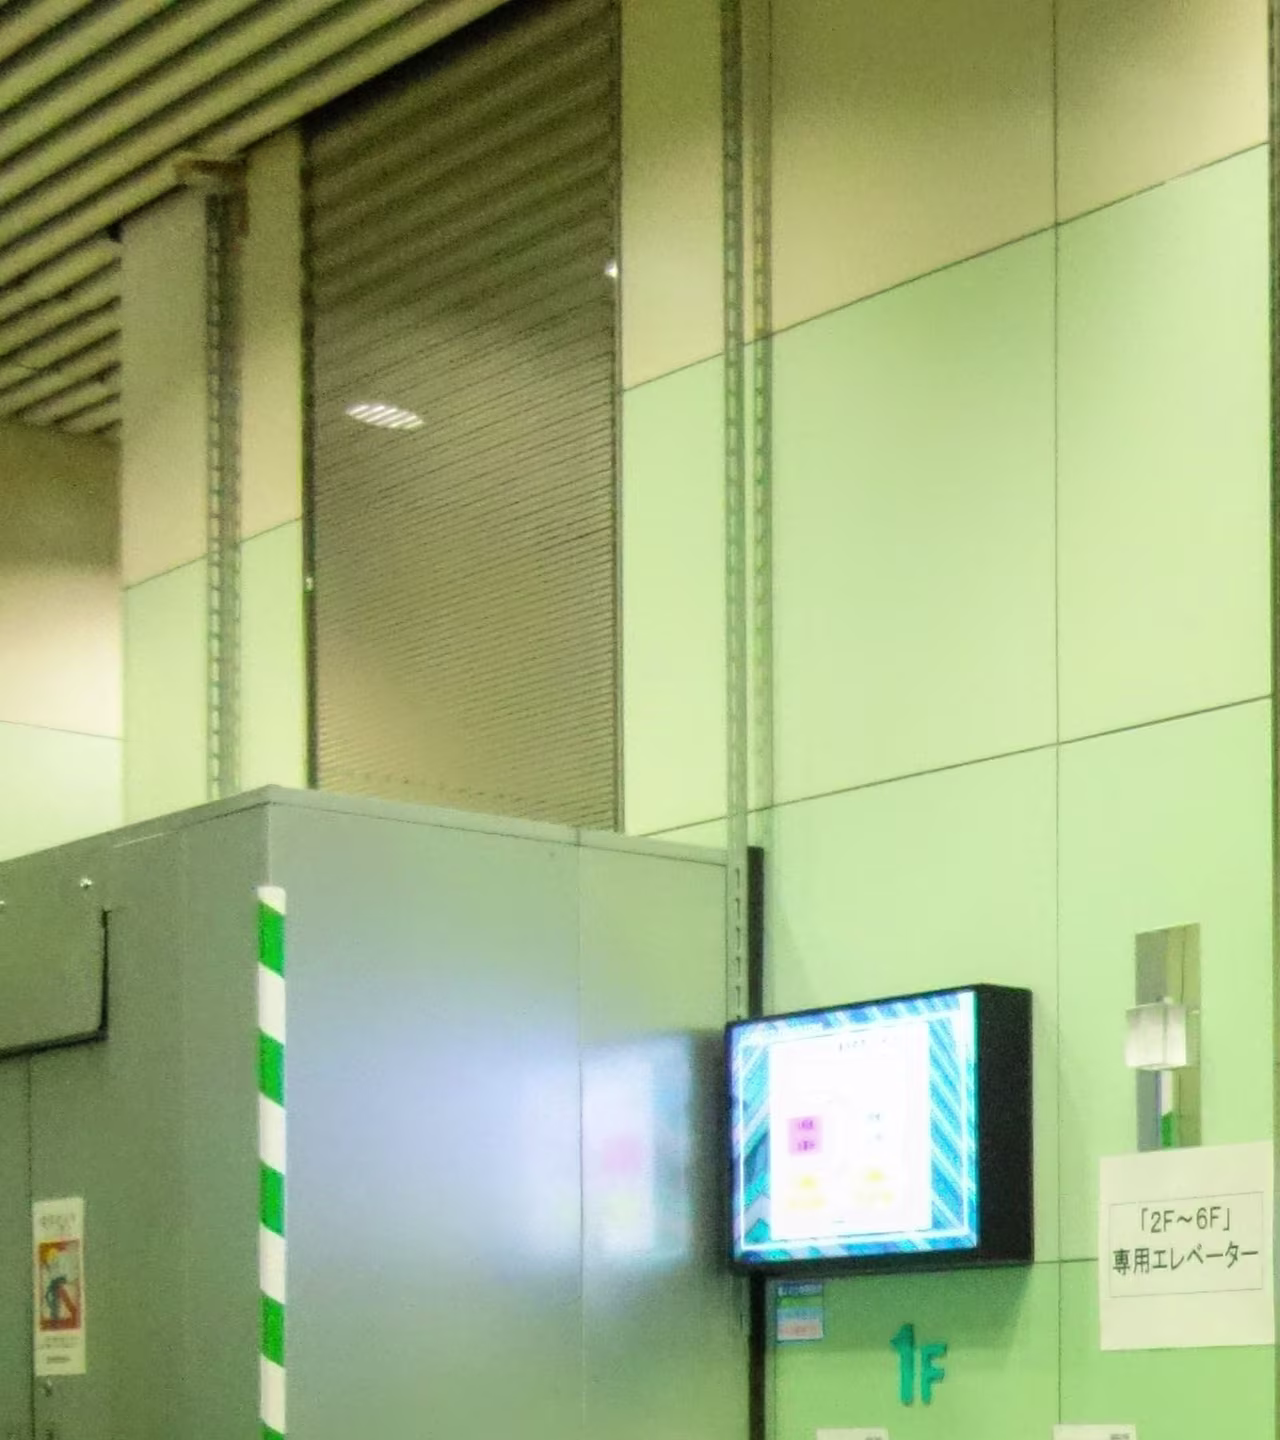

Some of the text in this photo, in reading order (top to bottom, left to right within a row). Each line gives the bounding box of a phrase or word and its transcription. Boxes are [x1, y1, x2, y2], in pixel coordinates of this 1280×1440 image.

[1112, 1240, 1260, 1276] 専用エレベーター
[889, 1322, 948, 1407] 1F
